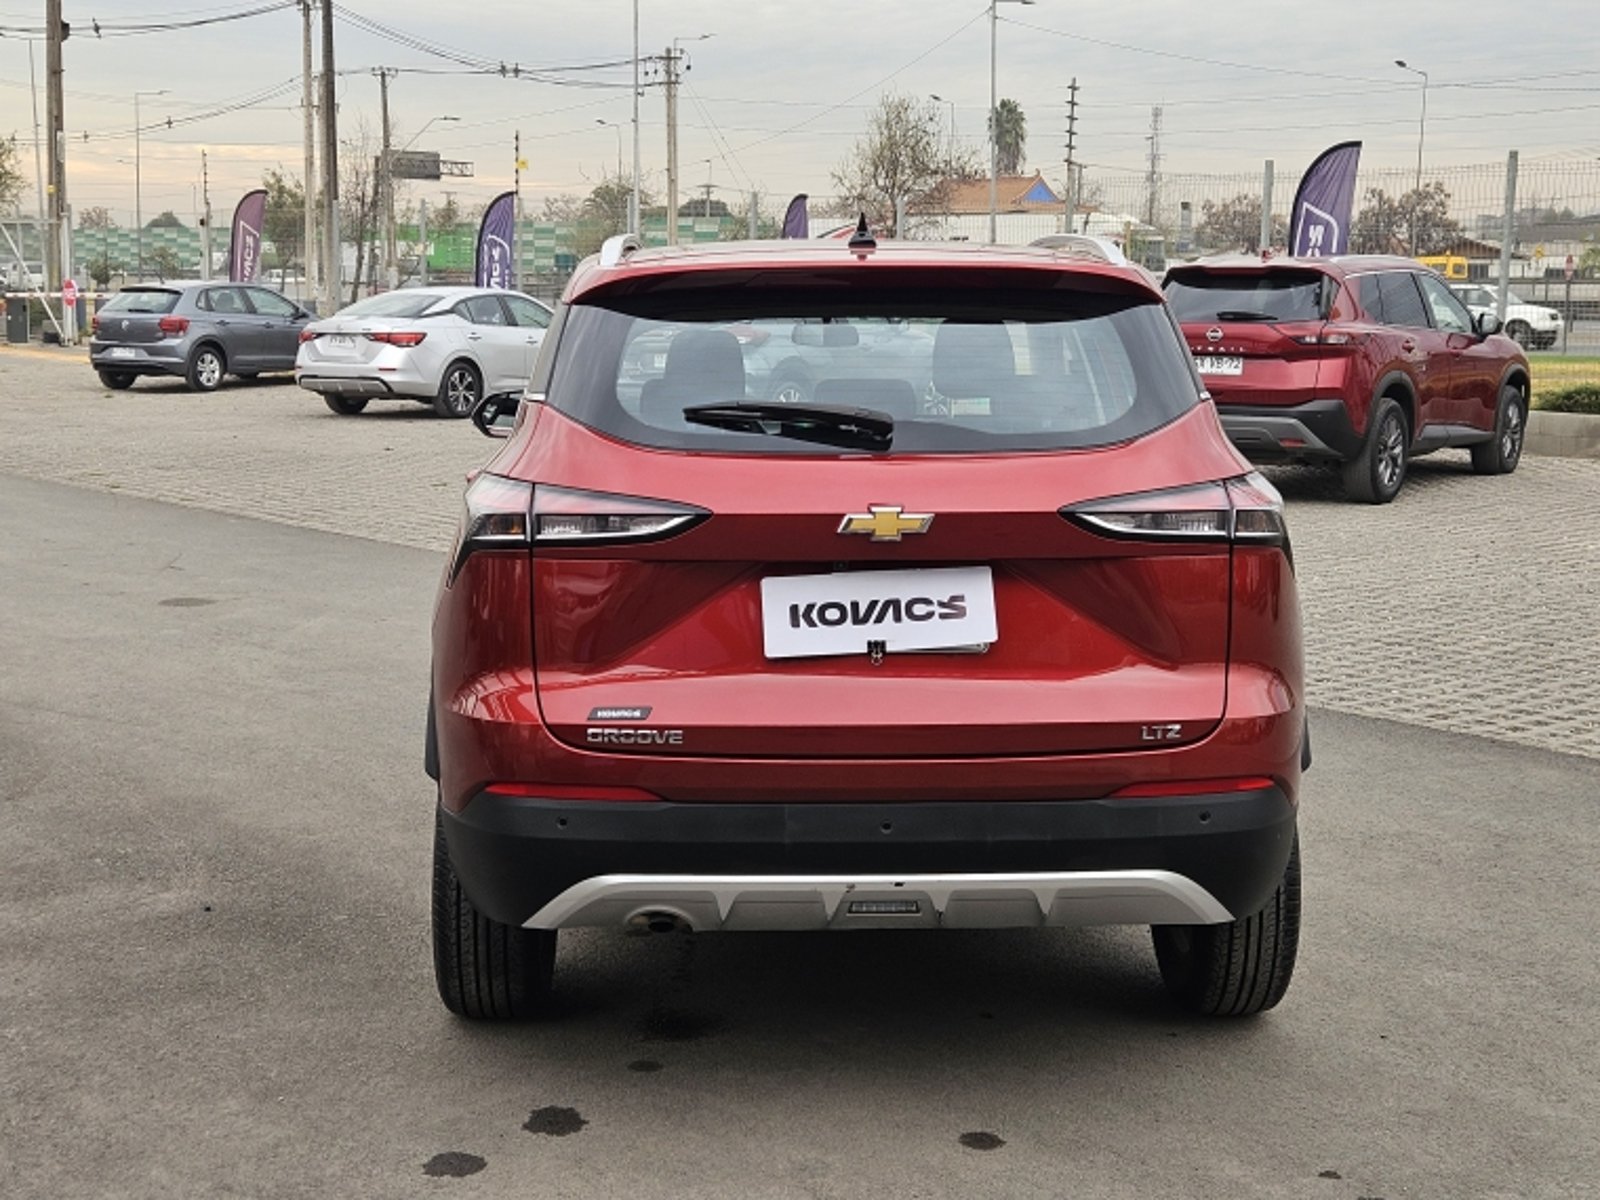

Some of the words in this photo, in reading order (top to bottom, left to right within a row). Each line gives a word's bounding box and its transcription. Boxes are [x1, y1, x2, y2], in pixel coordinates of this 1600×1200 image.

[788, 594, 968, 629] KOVACS
[586, 728, 684, 745] GROOVE
[1141, 724, 1182, 740] LTZ
